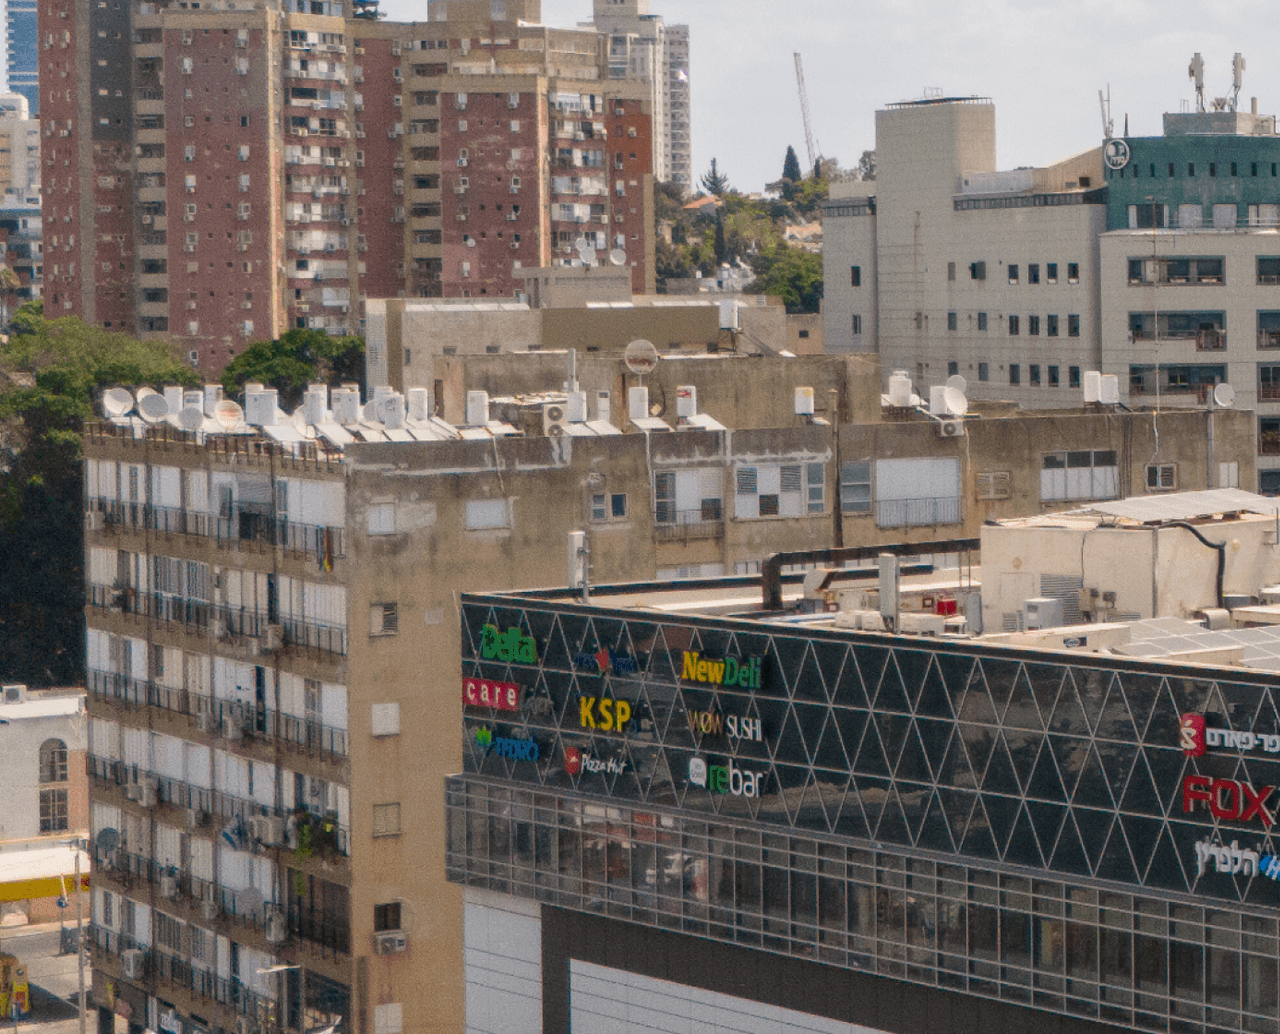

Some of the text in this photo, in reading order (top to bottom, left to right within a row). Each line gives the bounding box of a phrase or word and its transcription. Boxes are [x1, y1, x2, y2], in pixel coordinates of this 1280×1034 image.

[466, 682, 517, 707] care
[726, 714, 762, 741] SUSHI
[581, 754, 627, 775] Pizza Hut
[1184, 775, 1278, 826] FOX
